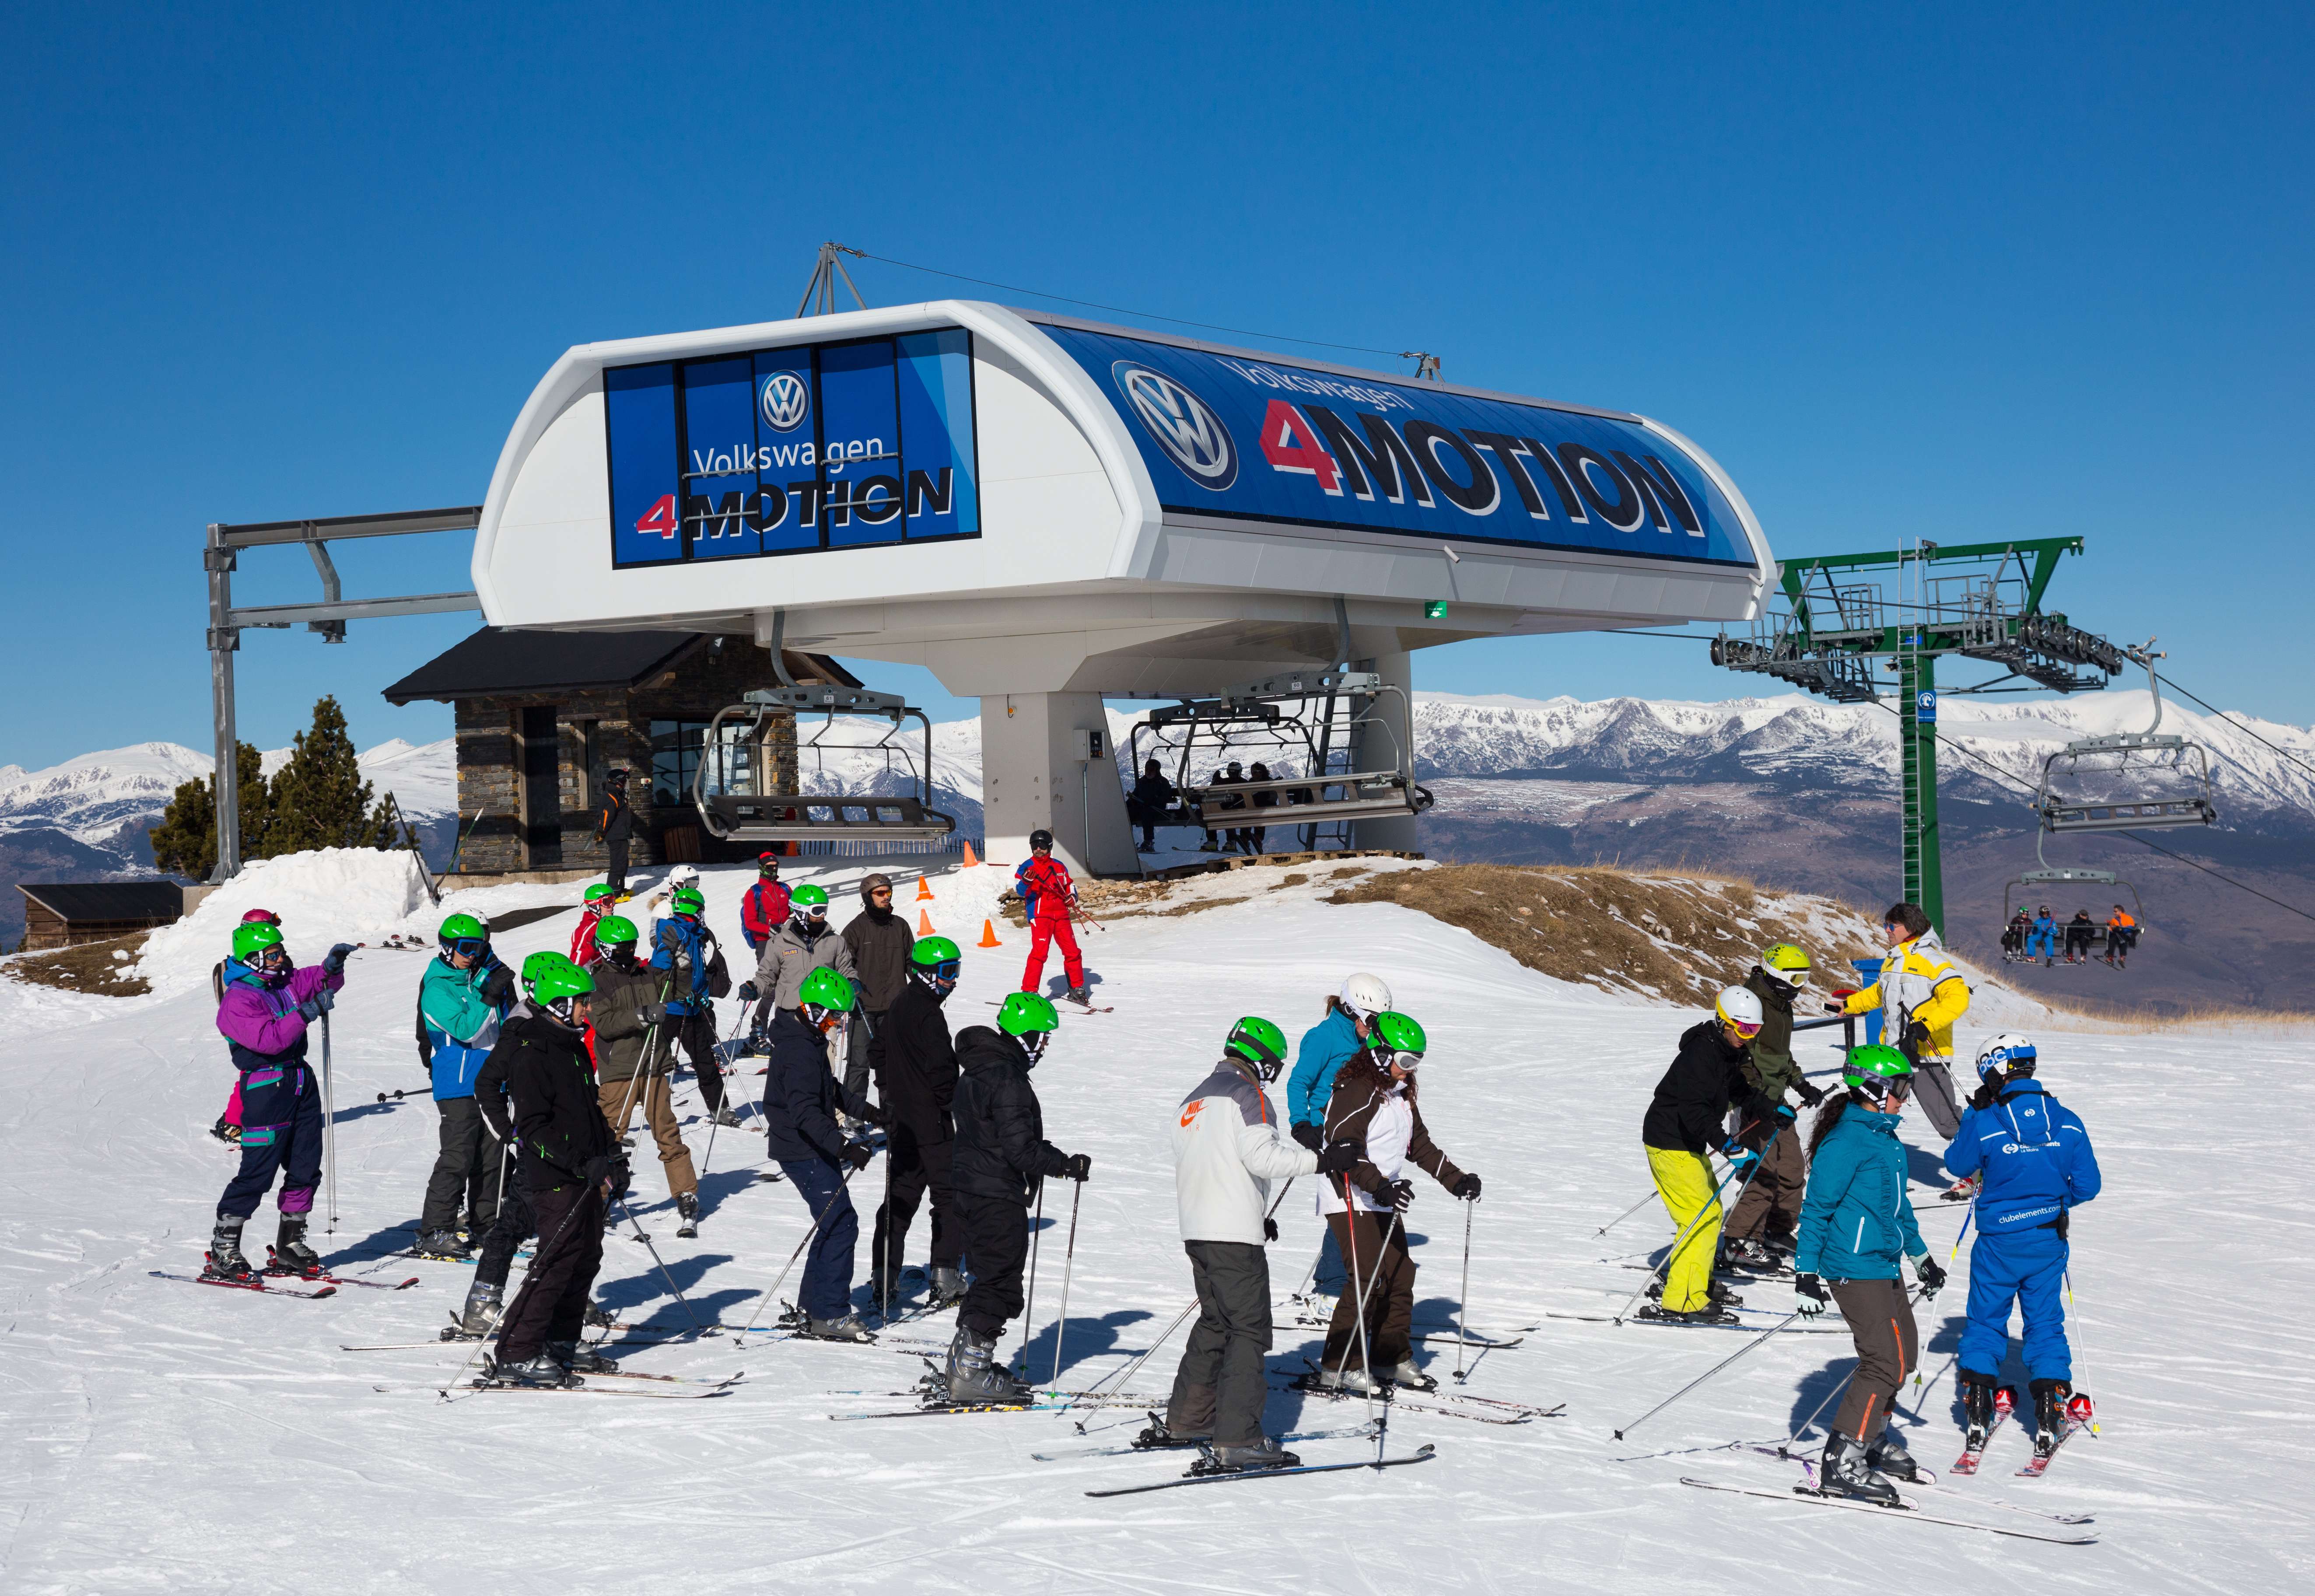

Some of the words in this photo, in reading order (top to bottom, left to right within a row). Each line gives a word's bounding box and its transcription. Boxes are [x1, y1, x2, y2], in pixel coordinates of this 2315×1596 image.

[1215, 359, 1415, 412] Volkswagen
[693, 438, 883, 478] Volkswagen
[1887, 1062, 1901, 1071] BRIKO
[1999, 1206, 2061, 1224] clubelements.com
